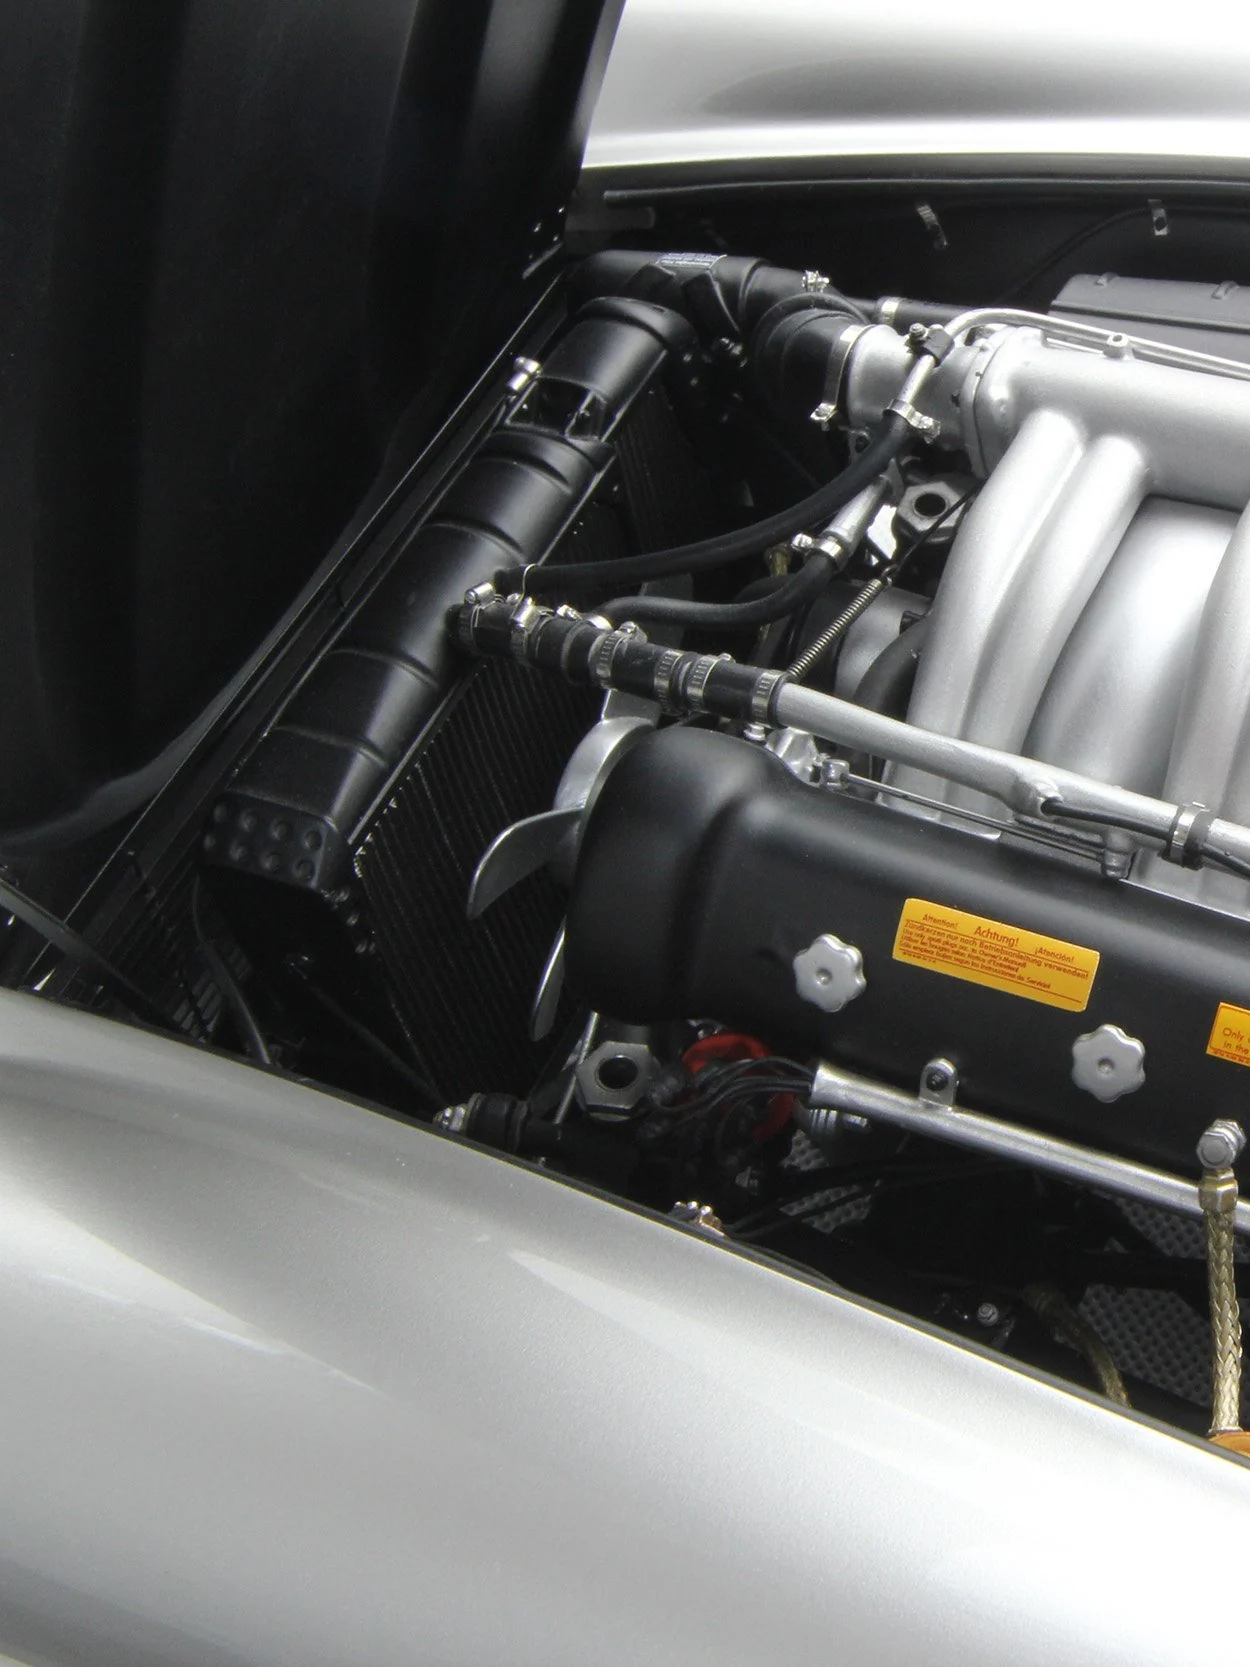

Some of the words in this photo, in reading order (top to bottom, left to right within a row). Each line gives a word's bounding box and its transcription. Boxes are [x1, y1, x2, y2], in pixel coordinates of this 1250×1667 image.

[922, 914, 958, 930] Attention!
[972, 926, 1019, 948] Achtung!
[1034, 947, 1075, 964] ¡Atención!
[1044, 962, 1089, 980] verwenden!
[1222, 1027, 1244, 1042] Only
[1223, 1041, 1232, 1049] in
[1235, 1044, 1249, 1055] the
